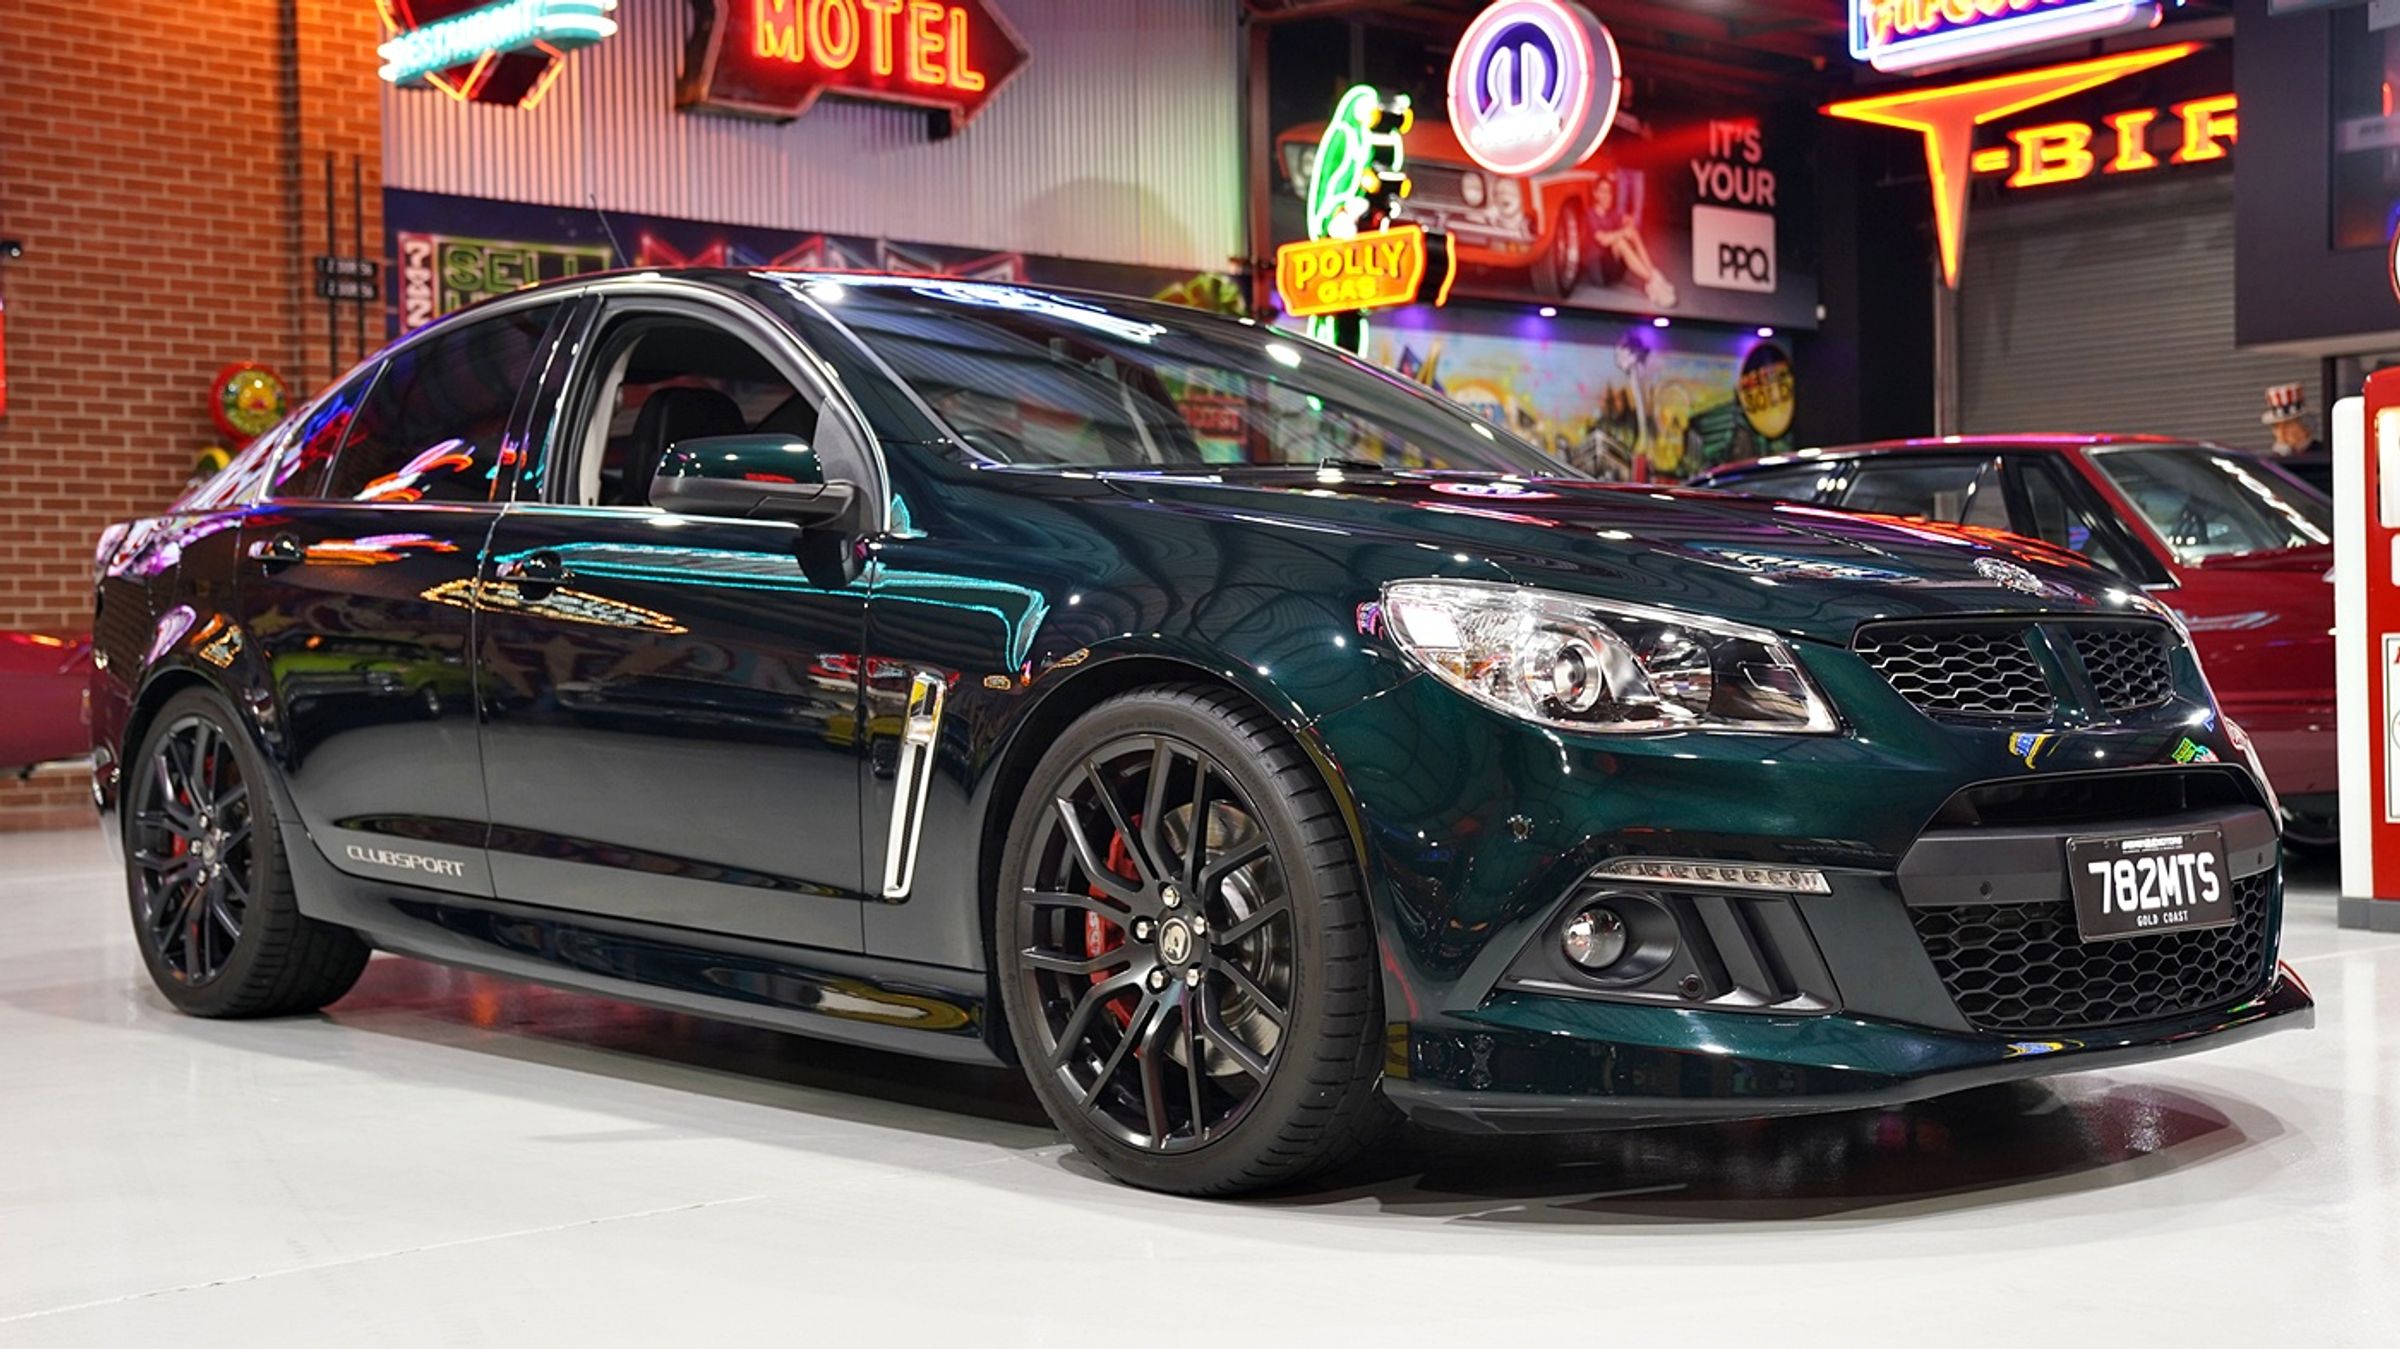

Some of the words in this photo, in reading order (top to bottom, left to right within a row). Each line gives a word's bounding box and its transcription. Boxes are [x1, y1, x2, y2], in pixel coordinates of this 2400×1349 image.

[755, 0, 986, 92] MOTEL
[1709, 119, 1763, 164] IT'S
[1690, 159, 1776, 207] YOUR
[1292, 239, 1405, 290] POLLY
[1718, 242, 1770, 284] PPQ
[1316, 274, 1378, 304] GAS
[345, 844, 466, 878] CLUBSPORT
[2087, 851, 2221, 914] 782MTS
[2136, 913, 2159, 928] GOLD
[2163, 910, 2190, 925] COAST
